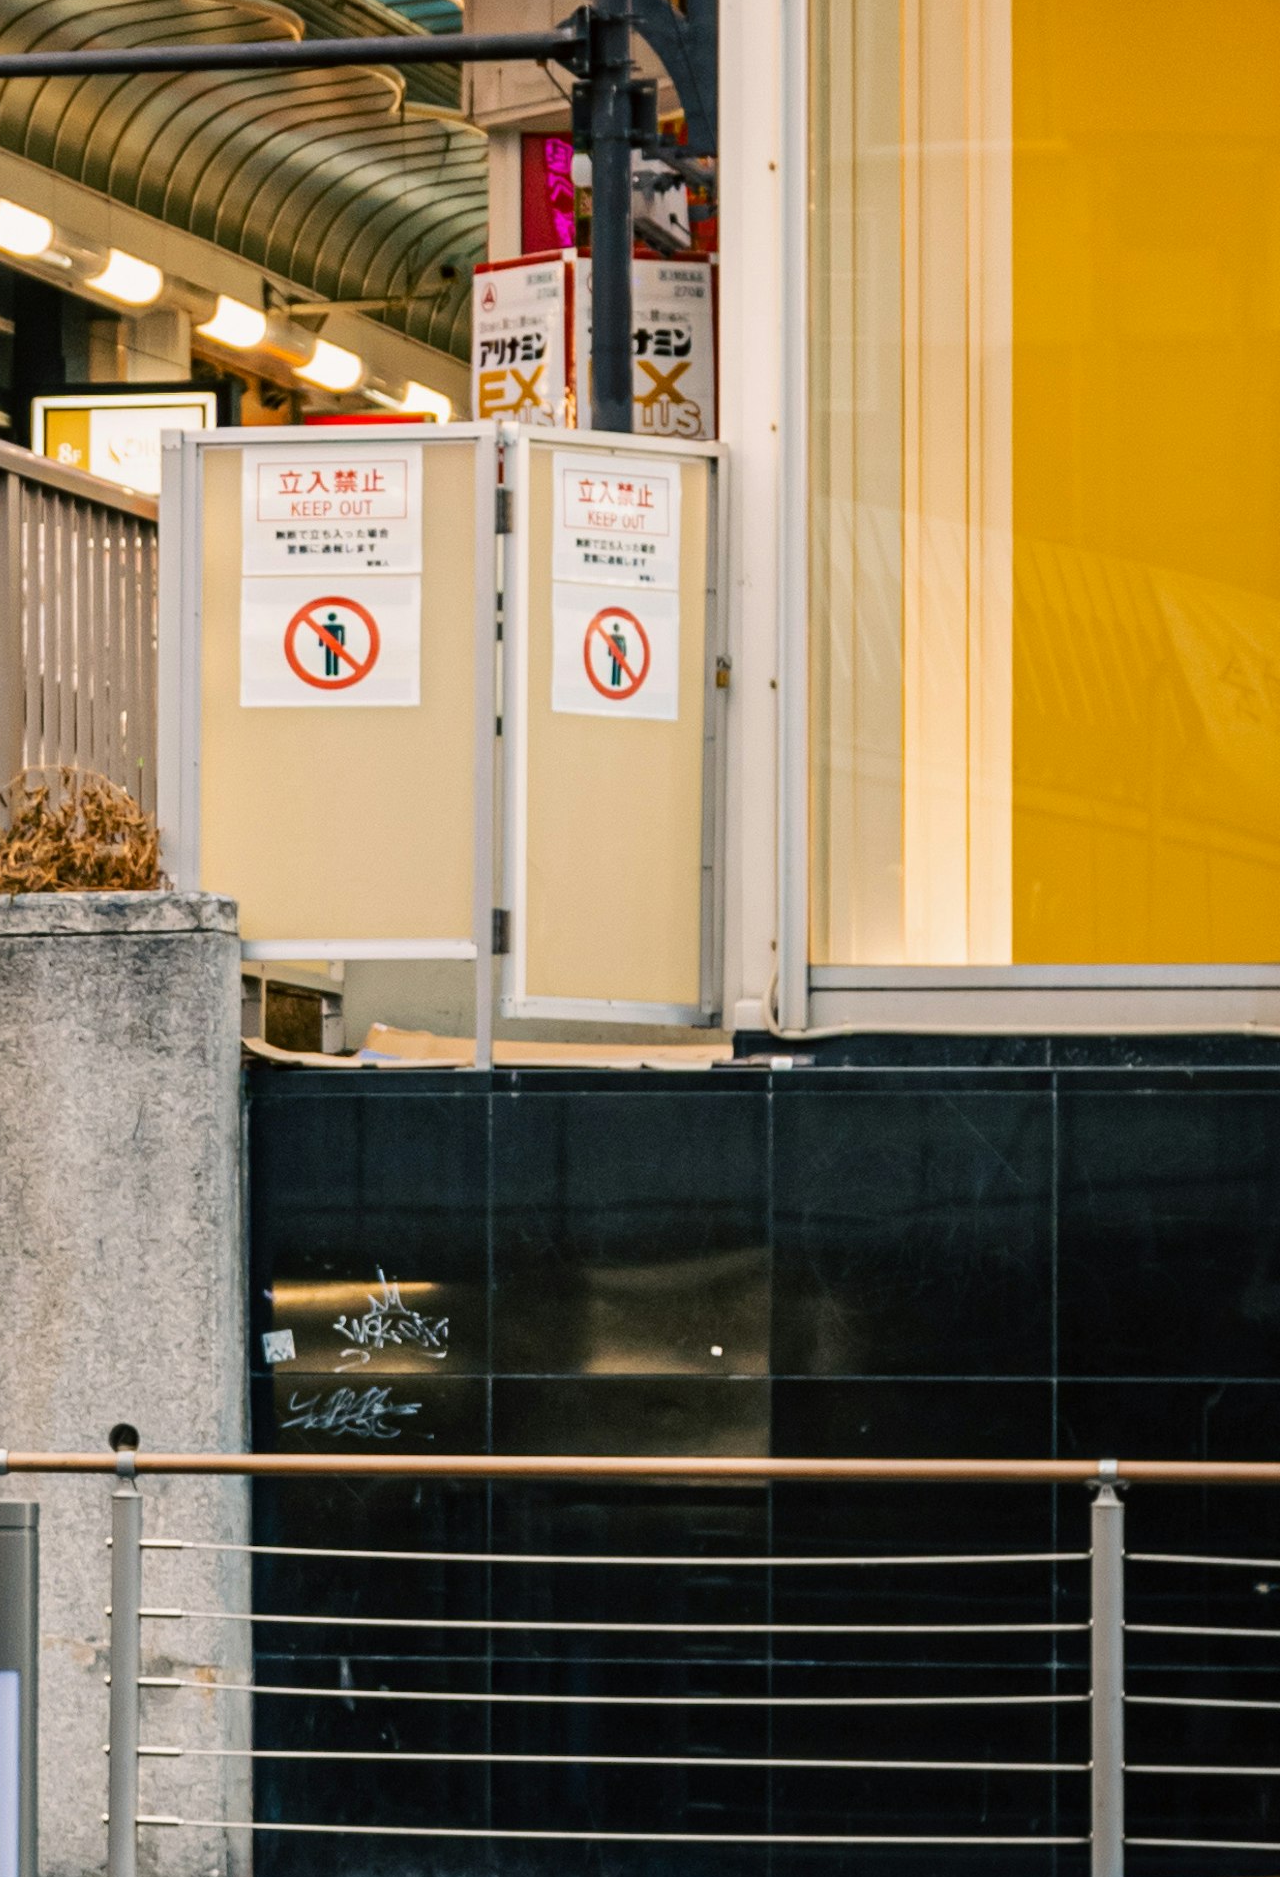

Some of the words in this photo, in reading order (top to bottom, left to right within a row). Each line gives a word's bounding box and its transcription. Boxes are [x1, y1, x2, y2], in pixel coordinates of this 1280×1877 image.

[480, 332, 548, 368] アリナミン
[478, 364, 545, 420] EX
[634, 397, 704, 438] LUS
[278, 467, 386, 495] 立入禁止
[578, 478, 655, 509] 立入禁止
[290, 499, 333, 517] KEEP
[339, 499, 374, 516] OUT
[587, 509, 618, 528] KEEP
[621, 513, 647, 530] OUT
